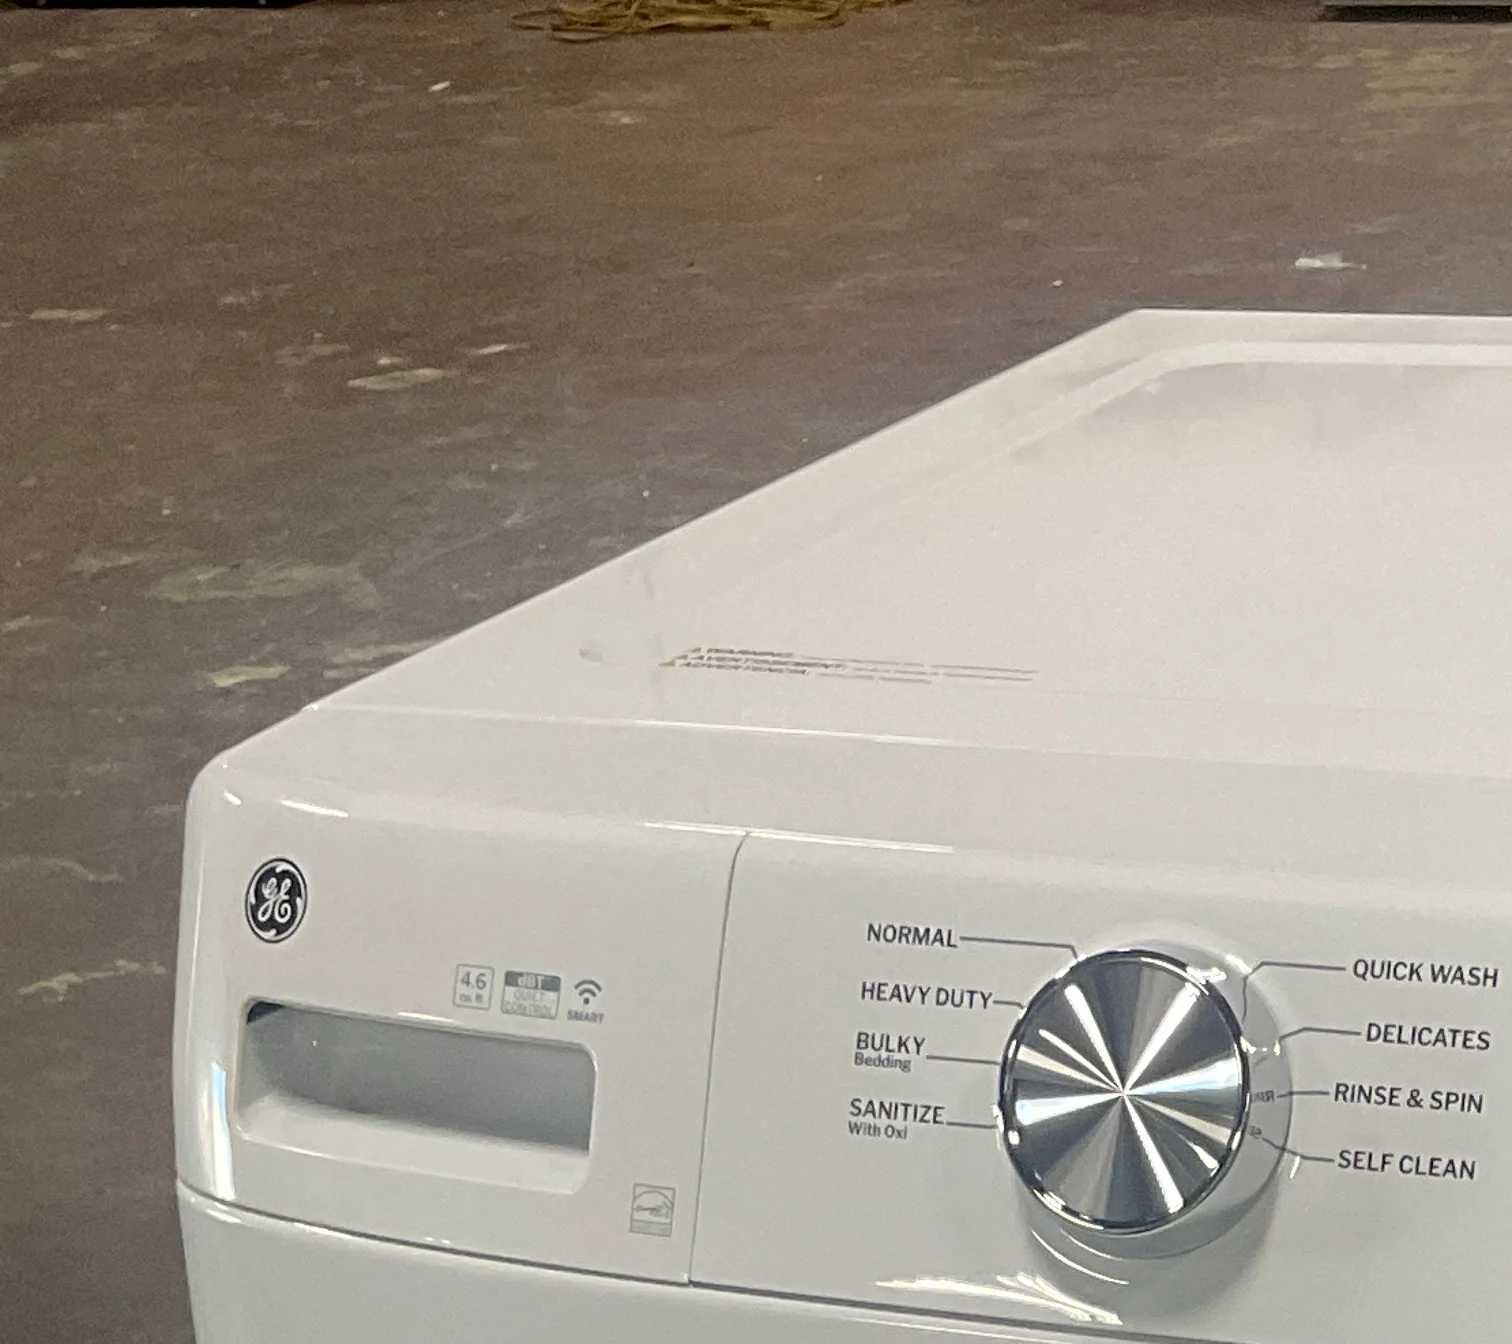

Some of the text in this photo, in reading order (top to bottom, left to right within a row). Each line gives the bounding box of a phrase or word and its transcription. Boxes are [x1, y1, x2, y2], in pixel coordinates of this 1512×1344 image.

[867, 923, 958, 948] NORMAL
[460, 971, 487, 990] 4.6
[1353, 959, 1499, 988] QUICK WASH
[861, 981, 993, 1009] HEAVY DUTY
[567, 1009, 604, 1024] SMART
[856, 1031, 926, 1055] BULKY
[1366, 1022, 1491, 1051] DELICATES
[854, 1052, 912, 1072] Bedding
[1334, 1082, 1483, 1113] RINSE & SPIN
[849, 1098, 945, 1125] SANITIZE
[848, 1120, 908, 1140] With Oxi
[1337, 1149, 1476, 1180] SELF CLEAN
